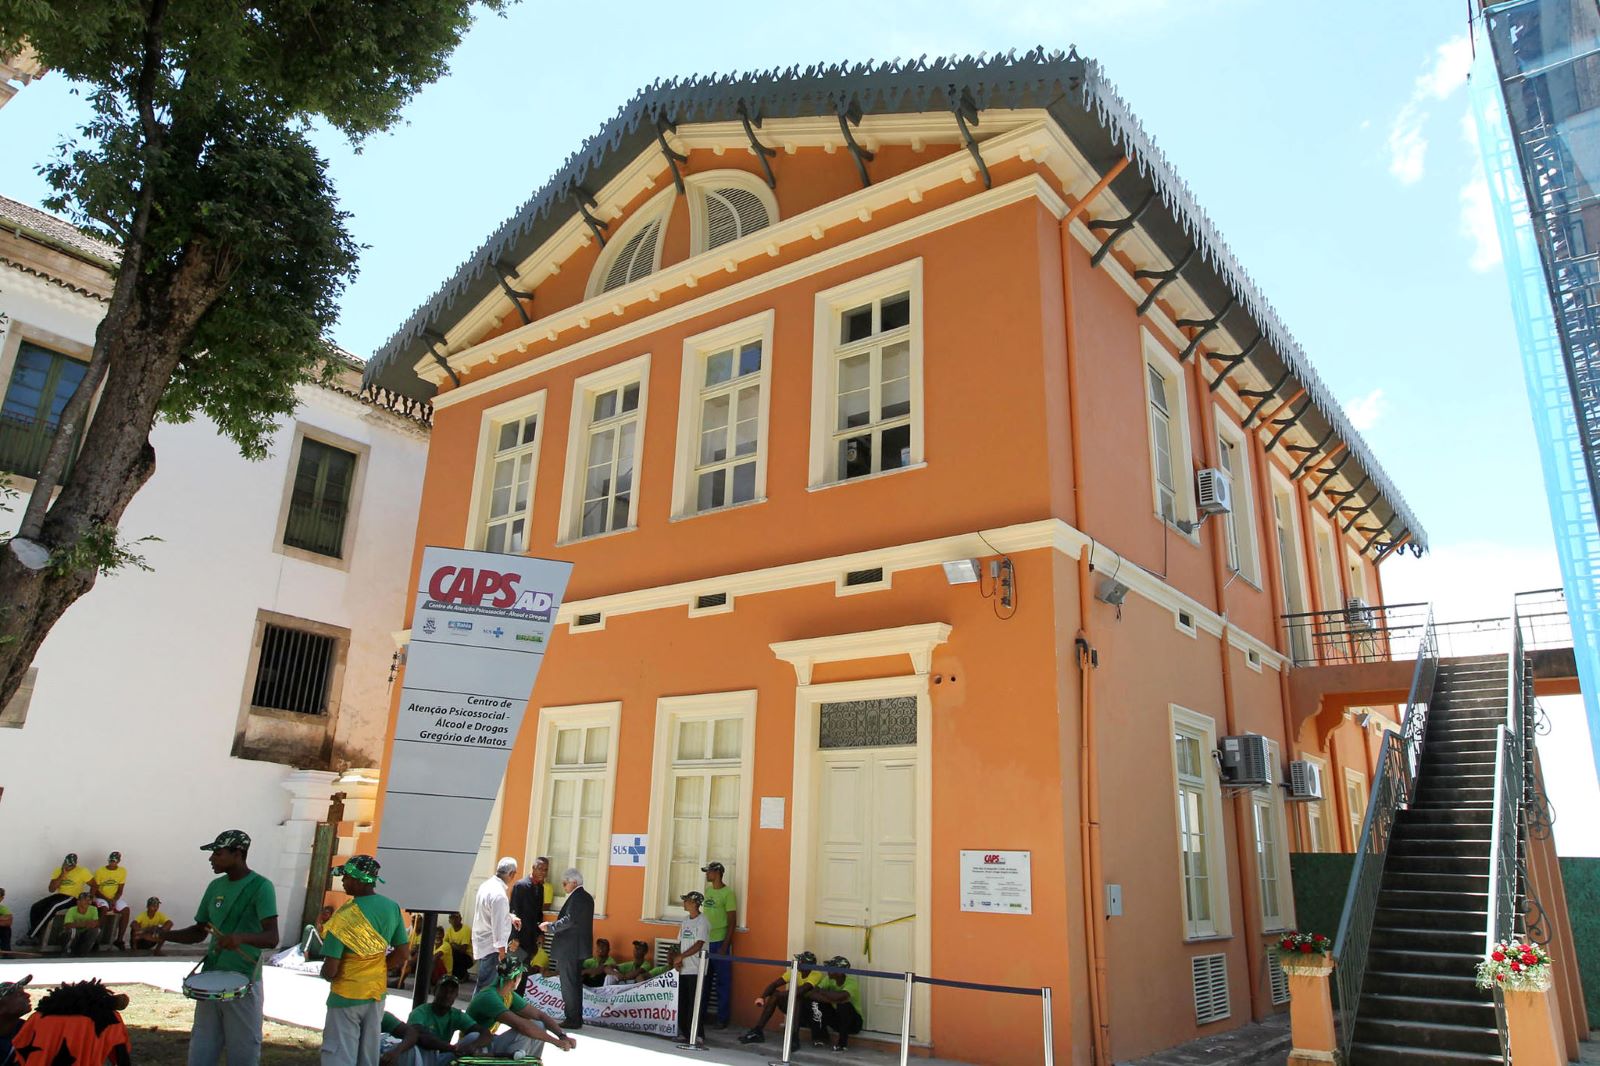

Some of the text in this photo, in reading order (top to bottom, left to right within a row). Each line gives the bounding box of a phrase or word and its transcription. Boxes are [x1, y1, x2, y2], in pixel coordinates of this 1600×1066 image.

[428, 565, 551, 611] CAPS AD
[428, 601, 447, 609] Centro
[453, 604, 475, 613] Atenção
[475, 606, 506, 616] Psicossocial
[467, 696, 513, 709] Centro de
[408, 703, 448, 715] Atenção
[449, 706, 506, 720] Psicossocial
[435, 717, 466, 729] Álcool
[474, 722, 509, 734] Drogas
[419, 730, 508, 747] Gregório de Matos
[613, 845, 628, 855] SUS
[600, 1003, 677, 1022] Governador
